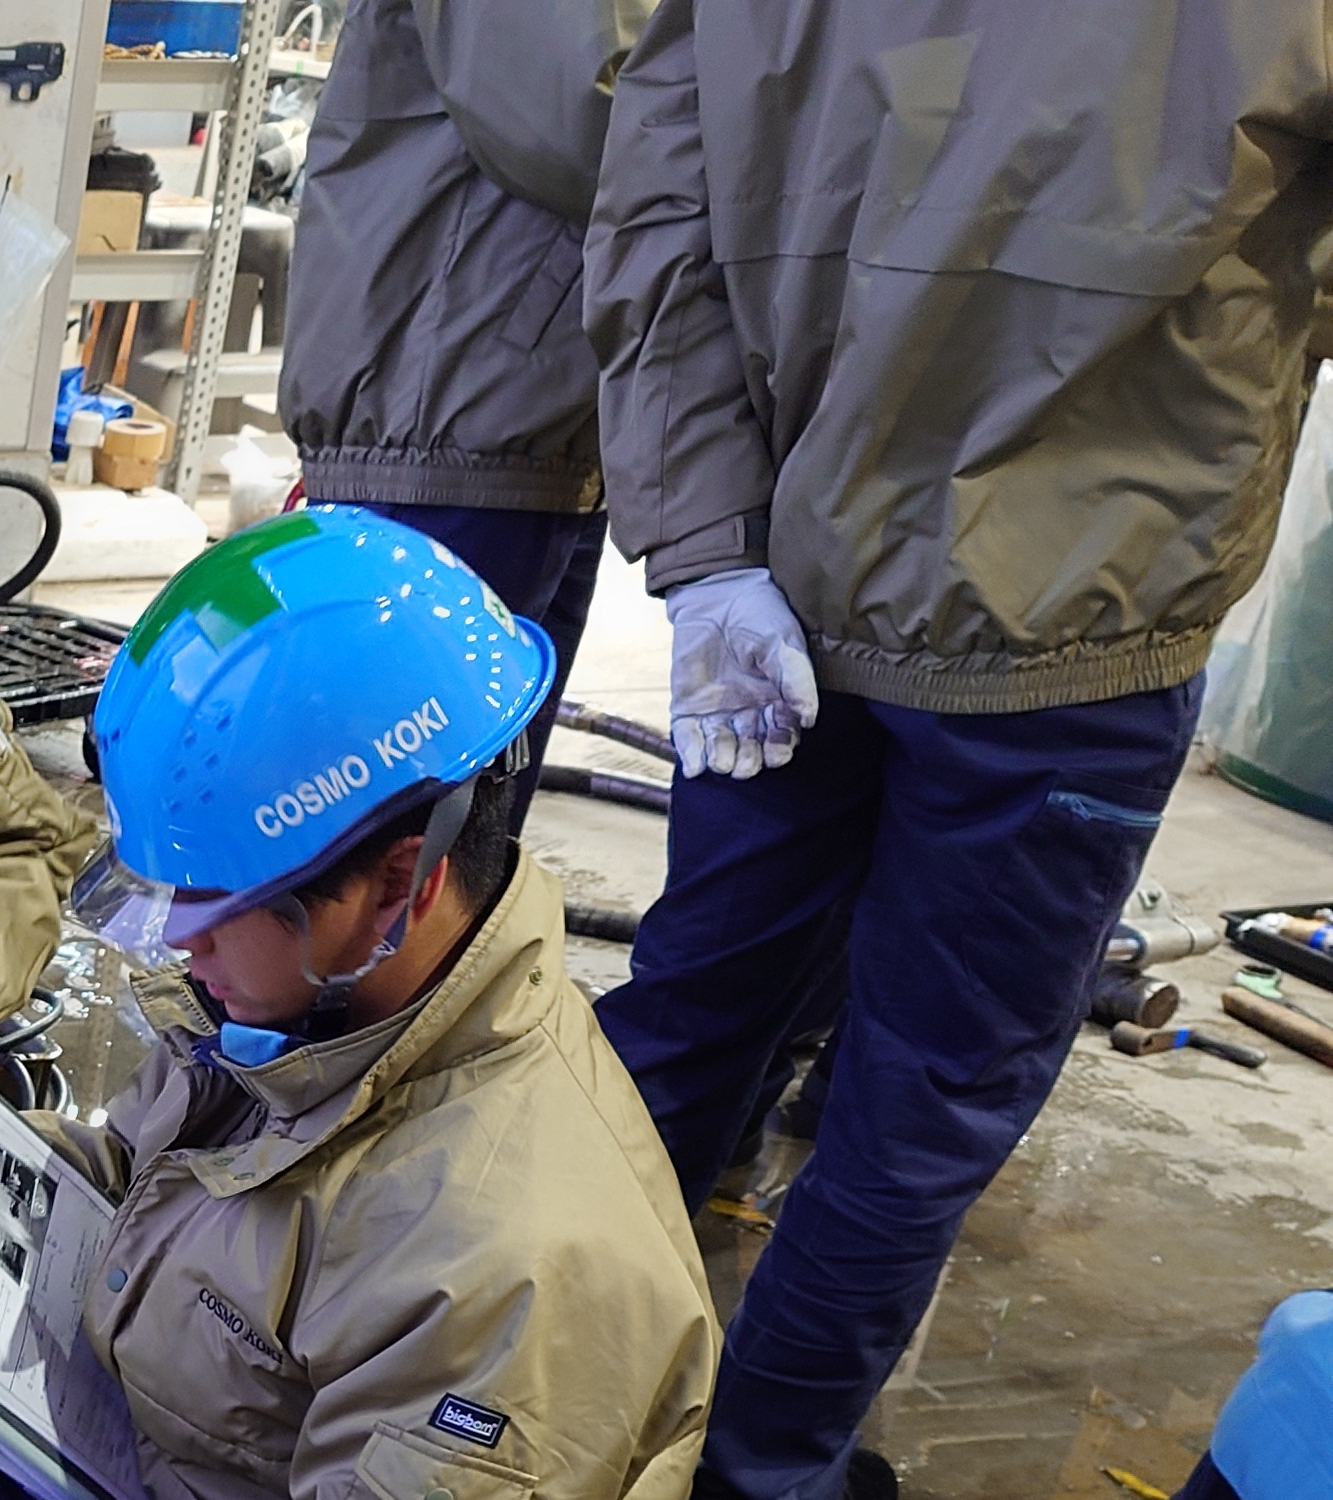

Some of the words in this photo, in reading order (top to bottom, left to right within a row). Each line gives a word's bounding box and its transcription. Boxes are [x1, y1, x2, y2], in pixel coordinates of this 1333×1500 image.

[254, 755, 371, 838] COSMO
[373, 696, 450, 768] KOKI
[199, 1287, 244, 1334] COSMO
[442, 1405, 494, 1437] bigborn
